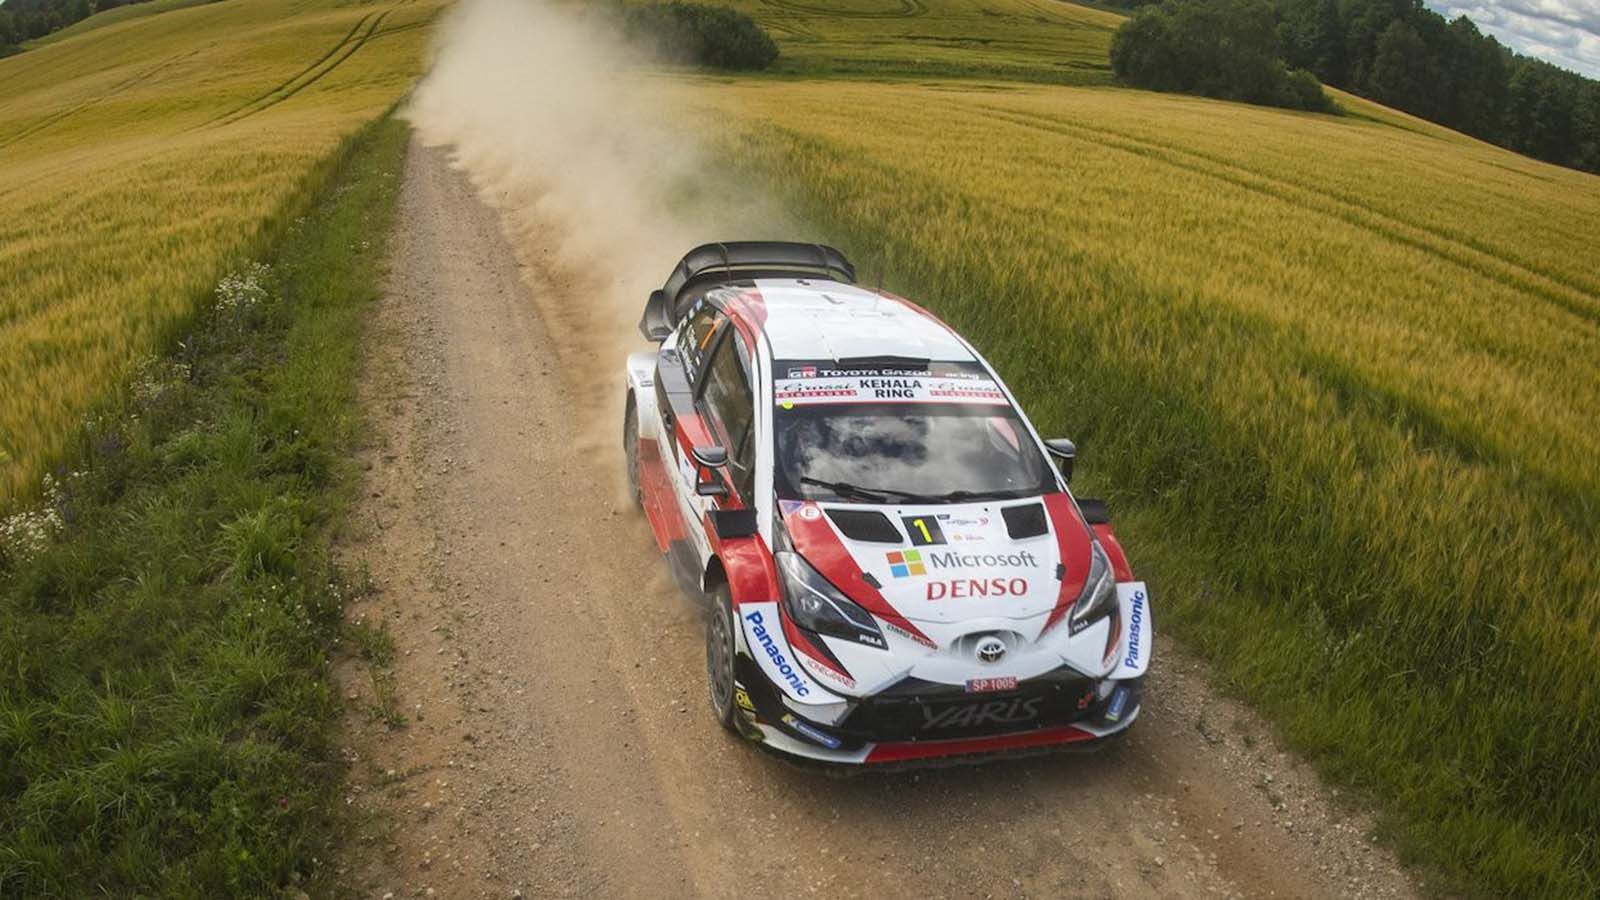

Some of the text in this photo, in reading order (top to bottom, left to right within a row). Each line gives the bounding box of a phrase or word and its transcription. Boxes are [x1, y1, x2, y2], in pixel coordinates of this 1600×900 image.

[788, 370, 814, 378] GR
[820, 369, 876, 377] TOYOTA
[860, 379, 922, 389] KEHALA
[875, 389, 915, 399] RING
[912, 518, 933, 543] 1
[930, 550, 1039, 569] Microsoft
[926, 577, 1028, 601] DENSO
[1125, 590, 1145, 669] Panasonic
[745, 610, 811, 698] Panasonic
[973, 678, 1016, 691] SP 1005
[920, 696, 1044, 729] YARIS
